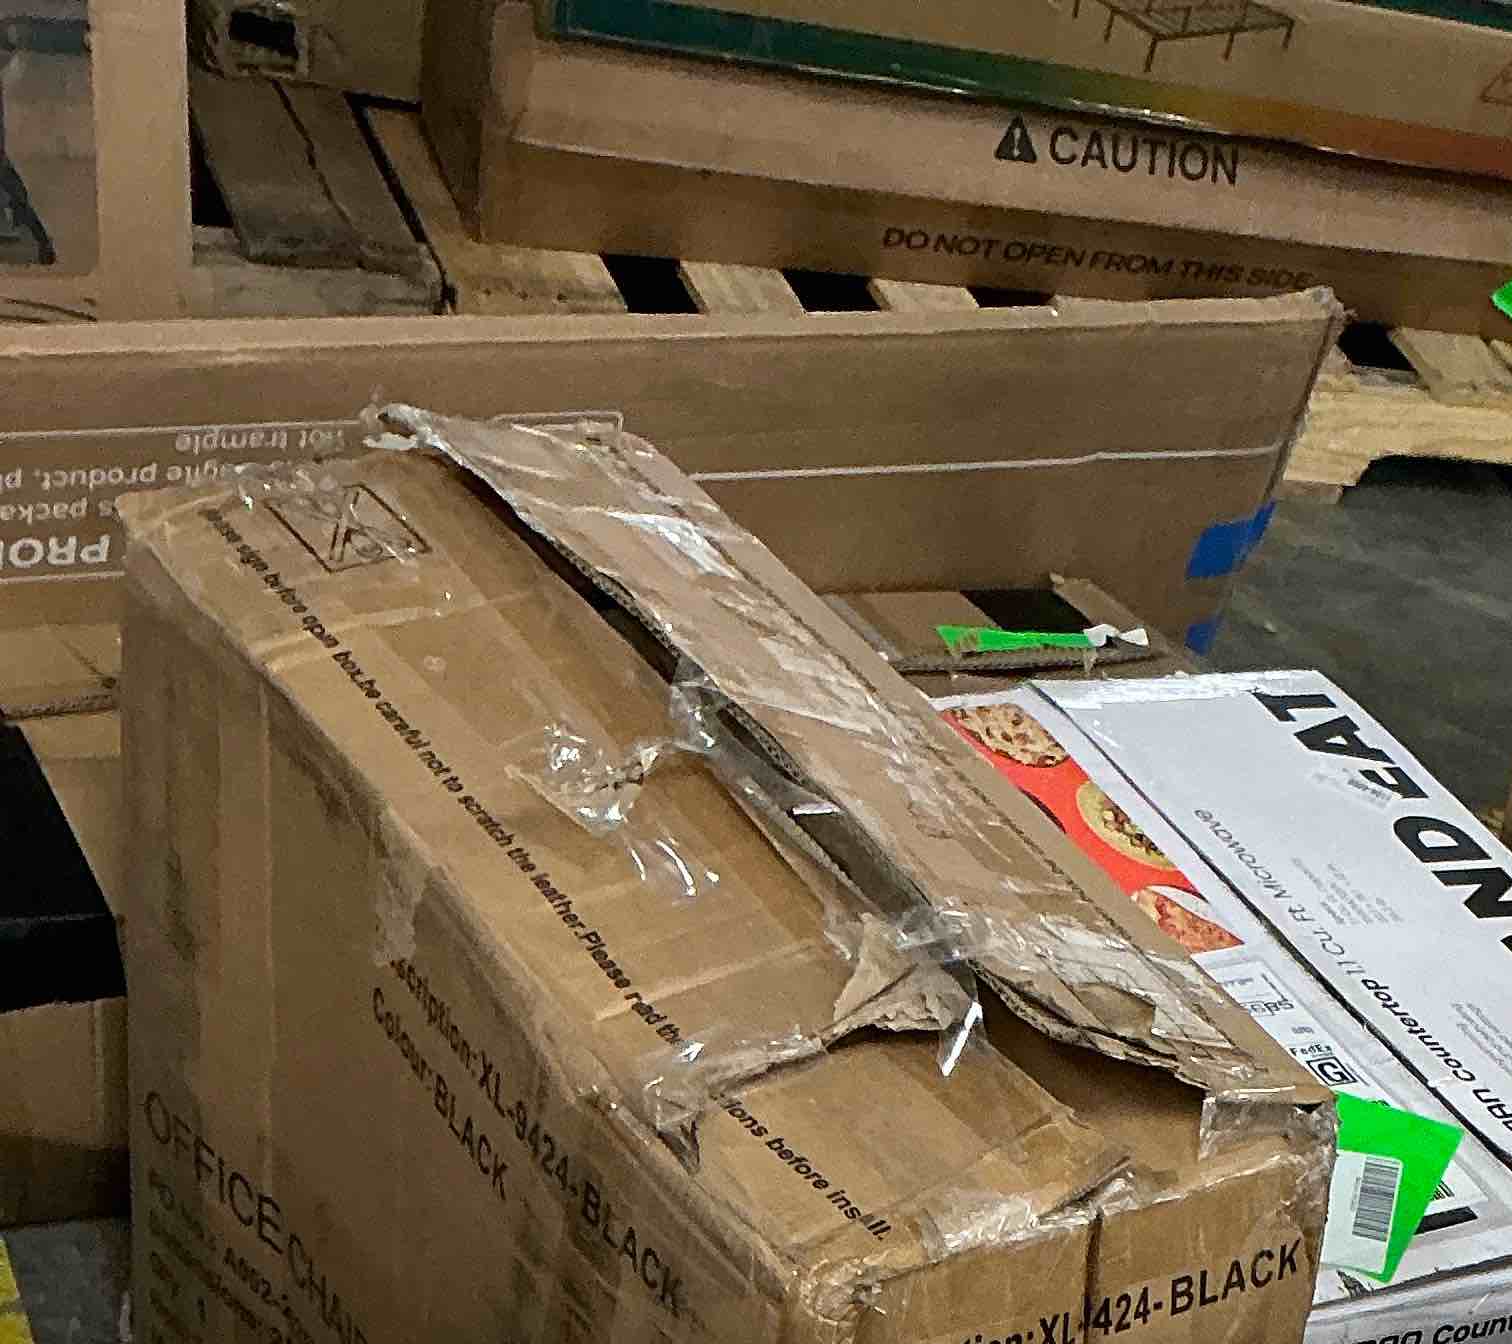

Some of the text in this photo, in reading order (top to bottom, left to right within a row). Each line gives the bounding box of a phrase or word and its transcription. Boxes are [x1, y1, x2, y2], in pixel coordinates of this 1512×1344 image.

[1049, 126, 1240, 185] CAUTION
[882, 227, 1315, 290] DO NOT OPEN FROM THIS SIDE
[175, 430, 288, 455] trample
[0, 535, 112, 569] PRO
[505, 847, 538, 874] the
[1194, 808, 1290, 899] Microwave
[1362, 978, 1476, 1083] Countertop
[389, 958, 687, 1322] scription:XL-9424-BLACK
[764, 1135, 830, 1192] before
[143, 1091, 283, 1256] OFFICE
